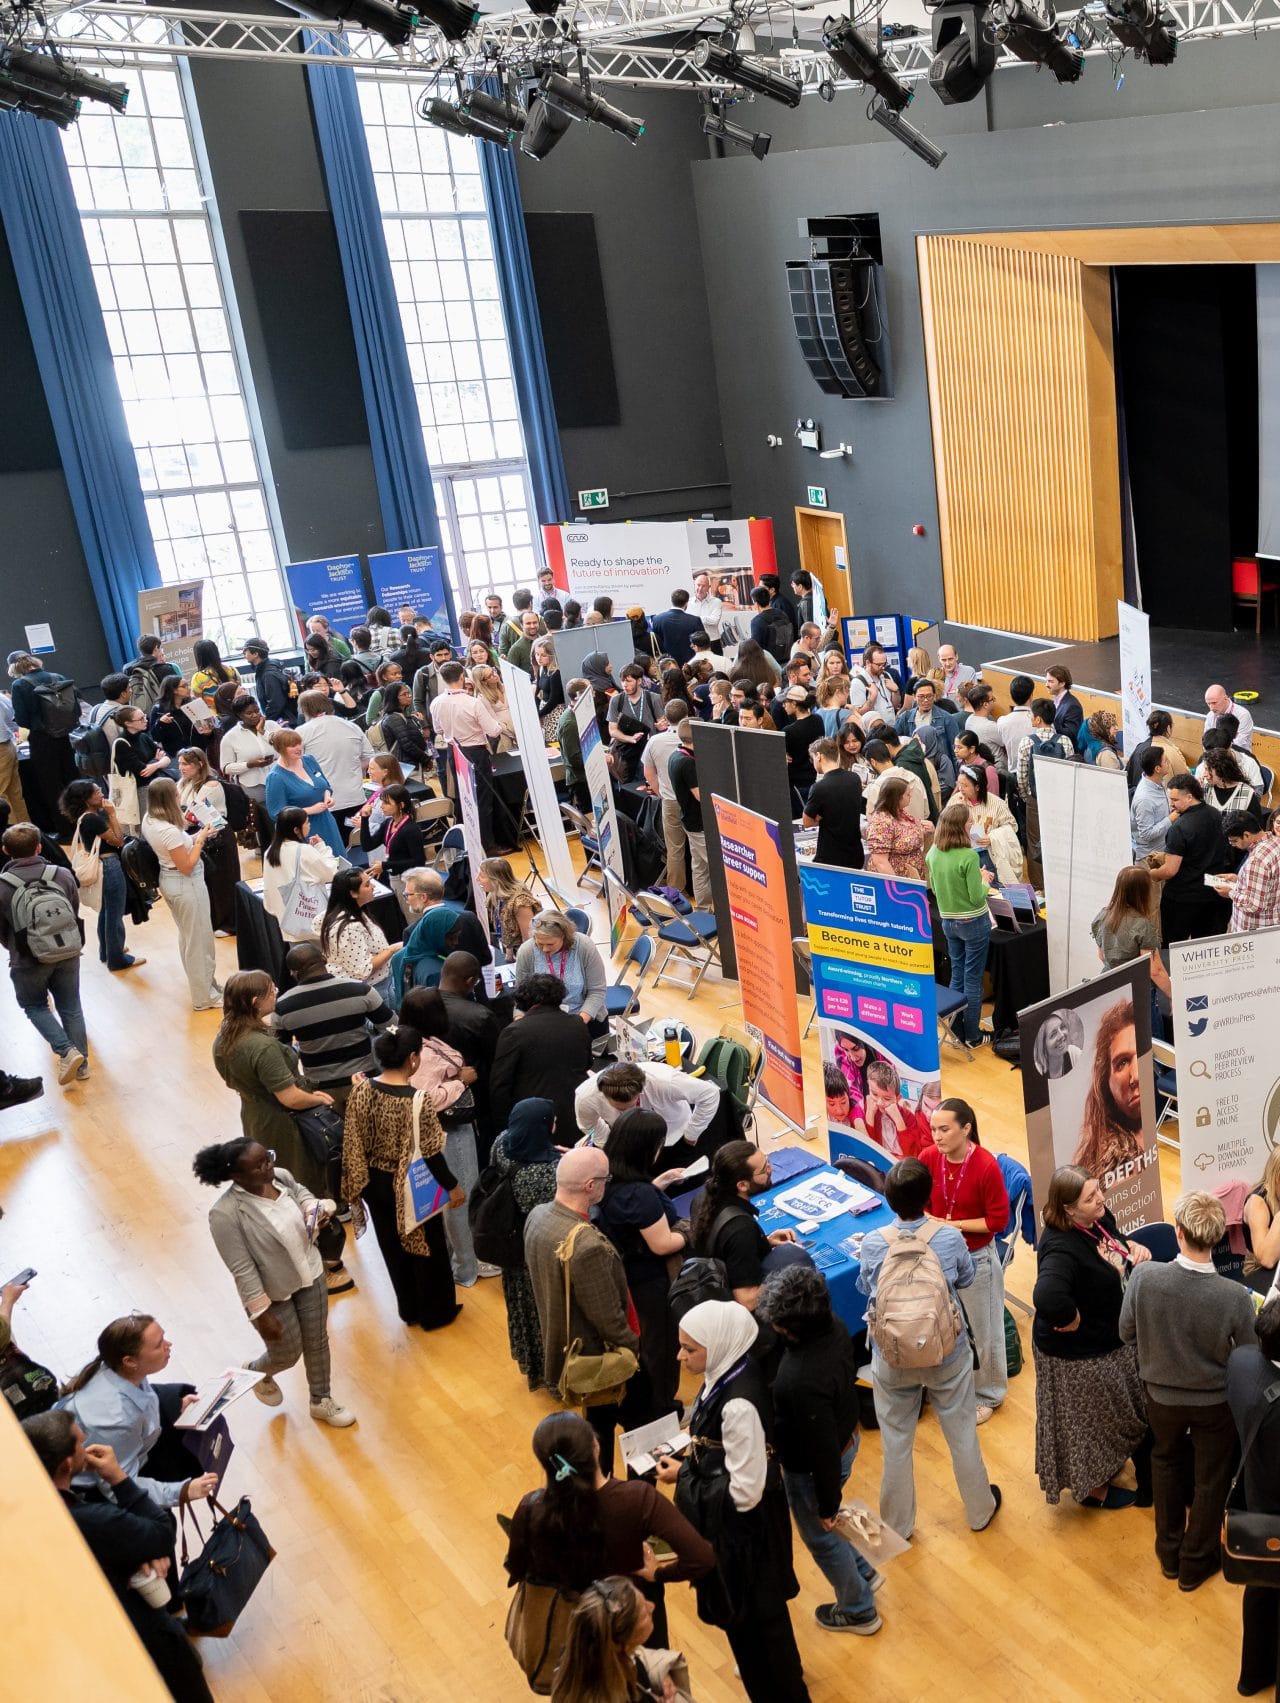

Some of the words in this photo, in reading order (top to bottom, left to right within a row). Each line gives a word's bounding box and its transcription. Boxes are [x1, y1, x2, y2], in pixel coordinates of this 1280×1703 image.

[571, 558, 601, 568] Ready
[603, 559, 613, 567] to
[615, 557, 645, 567] shape
[647, 556, 663, 565] the
[572, 569, 601, 578] future
[603, 568, 613, 577] of
[615, 566, 670, 577] innovation?
[720, 836, 755, 861] Researcher
[743, 861, 767, 884] support
[853, 886, 865, 894] THE
[818, 909, 854, 923] Transforming
[854, 915, 867, 924] lives
[868, 918, 890, 929] through
[891, 923, 914, 933] tutoring
[821, 930, 870, 949] Become
[873, 943, 881, 951] a
[884, 942, 914, 957] tutor
[1182, 946, 1220, 962] WHITE
[1224, 941, 1255, 956] ROSE
[1182, 956, 1229, 972] UNIVERSITY
[1232, 953, 1255, 964] PRESS
[863, 973, 881, 981] proudly
[828, 1003, 837, 1011] per
[837, 1004, 849, 1012] hour
[863, 1003, 877, 1011] Make
[861, 1010, 886, 1020] difference
[901, 1011, 914, 1019] Work
[1215, 1046, 1246, 1061] RIGOROUS
[1215, 1061, 1230, 1072] PEER
[1230, 1055, 1255, 1067] REVIEW
[1215, 1068, 1242, 1081] PROCESS
[1216, 1096, 1230, 1107] FREE
[1231, 1094, 1239, 1104] TO
[1216, 1104, 1239, 1118] ACCESS
[1216, 1114, 1239, 1127] ONLINE
[1217, 1138, 1247, 1152] MULTIPLE
[1218, 1146, 1254, 1162] DOWNLOAD
[1104, 1144, 1158, 1190] DEPTHS
[1218, 1159, 1247, 1172] FORMATS
[1130, 1179, 1142, 1195] of
